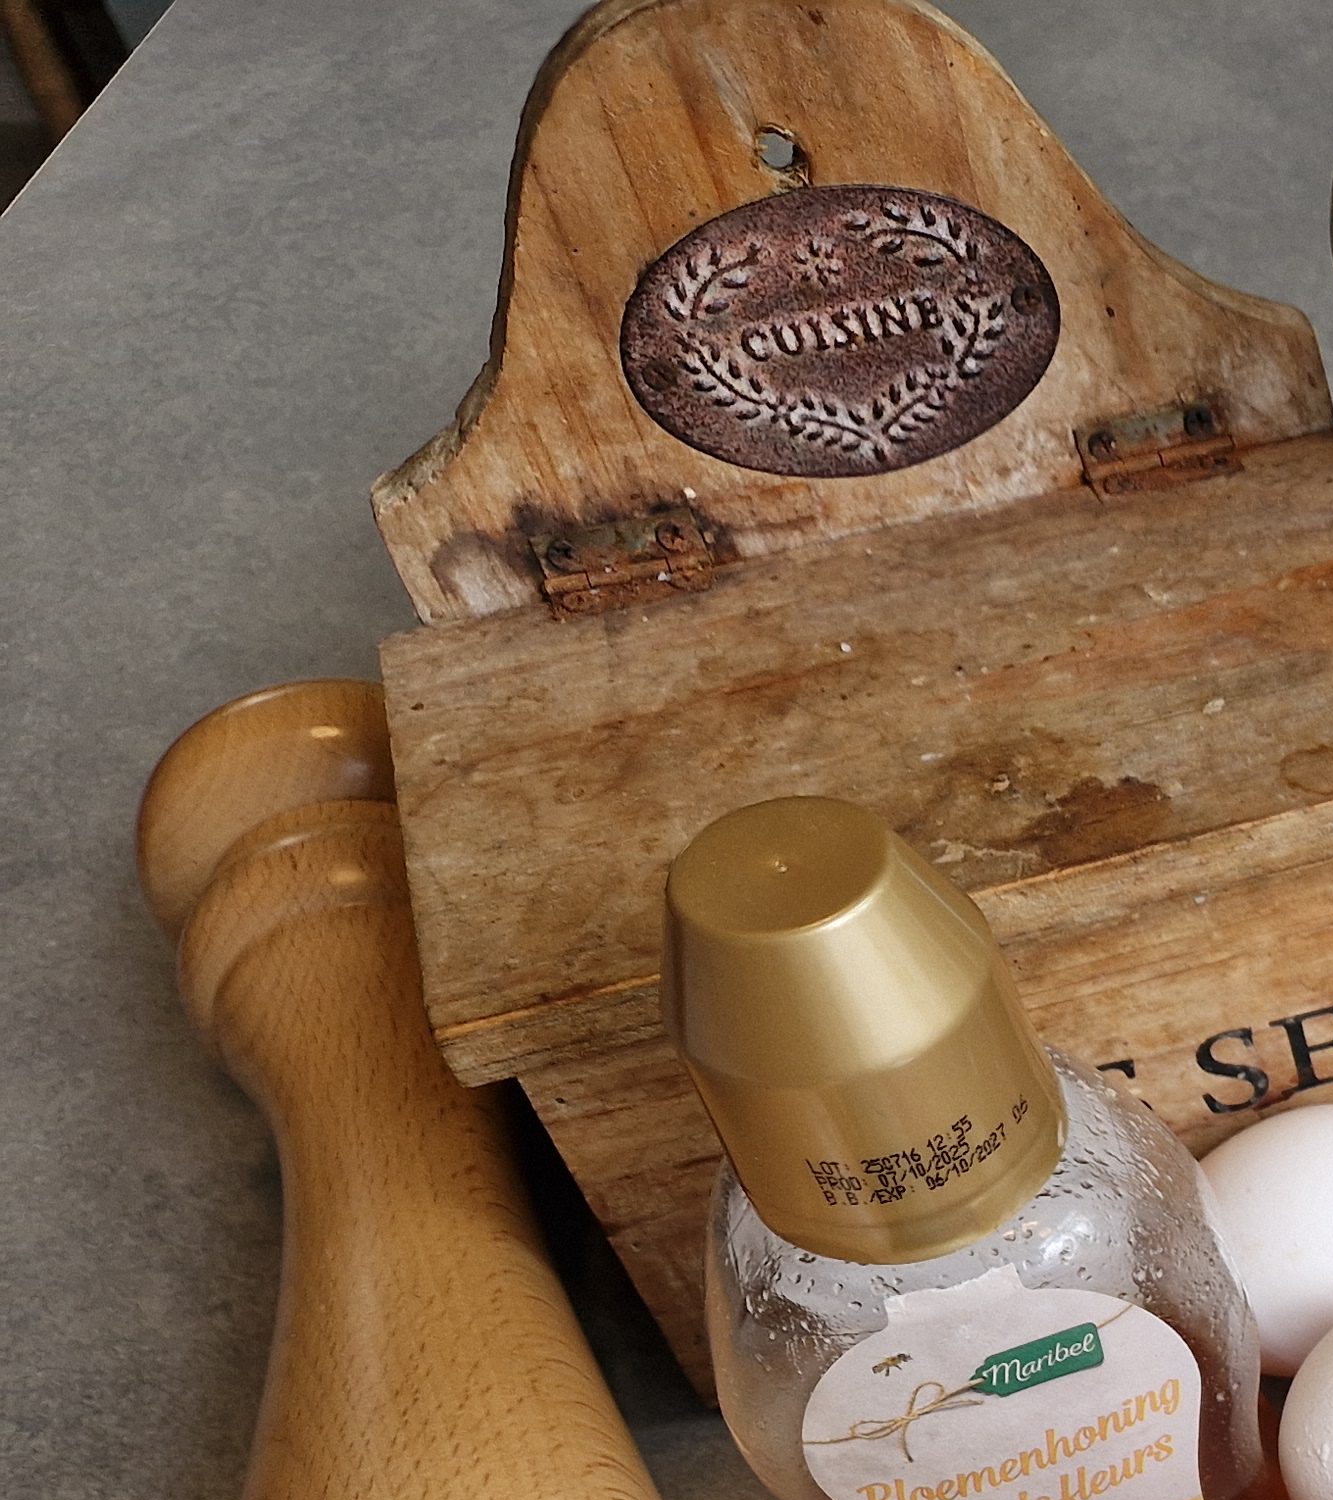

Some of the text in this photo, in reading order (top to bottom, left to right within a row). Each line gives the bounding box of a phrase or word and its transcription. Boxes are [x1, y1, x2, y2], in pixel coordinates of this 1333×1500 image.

[741, 294, 945, 361] CUISINE
[805, 1159, 850, 1176] LOT:
[926, 1115, 972, 1153] 12:55
[815, 1137, 970, 1191] PROD: 07/10/2025
[982, 1332, 1096, 1387] Maribel
